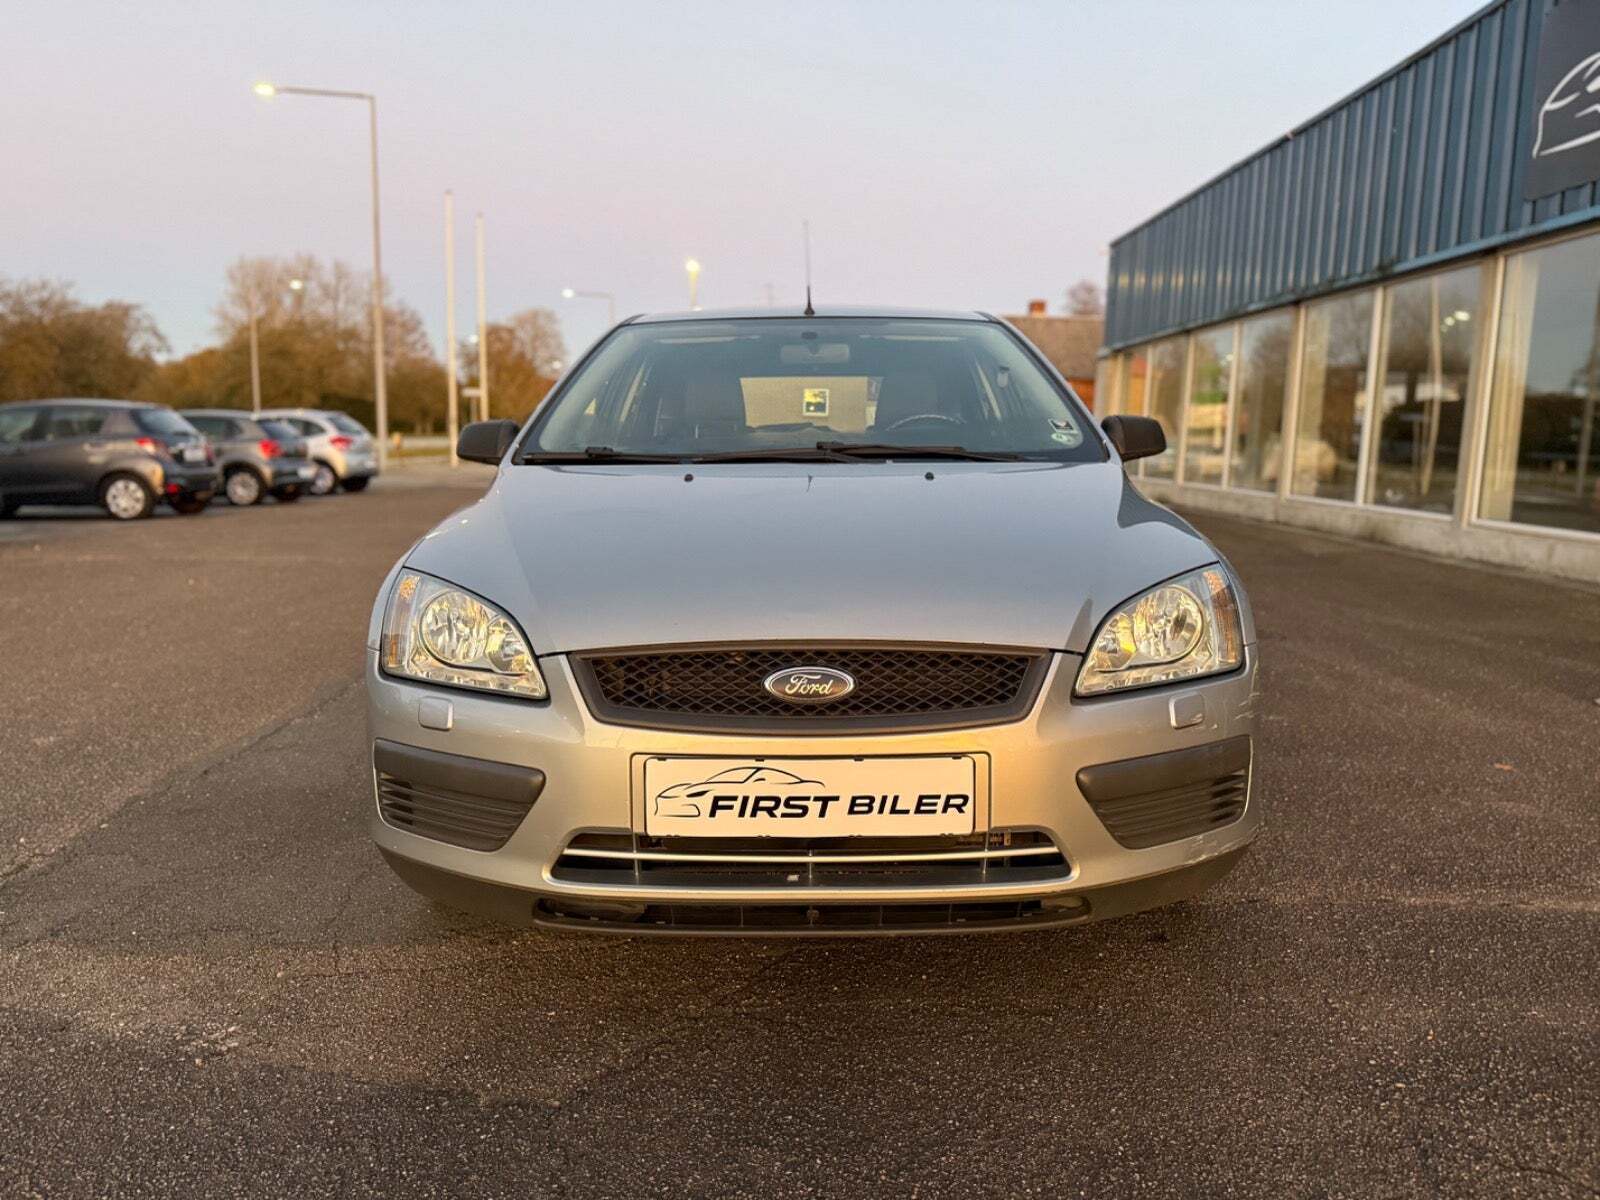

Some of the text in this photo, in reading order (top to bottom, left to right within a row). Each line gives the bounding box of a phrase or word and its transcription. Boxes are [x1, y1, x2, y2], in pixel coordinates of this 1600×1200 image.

[785, 674, 833, 695] Ford
[708, 794, 970, 818] FIRST BILER
